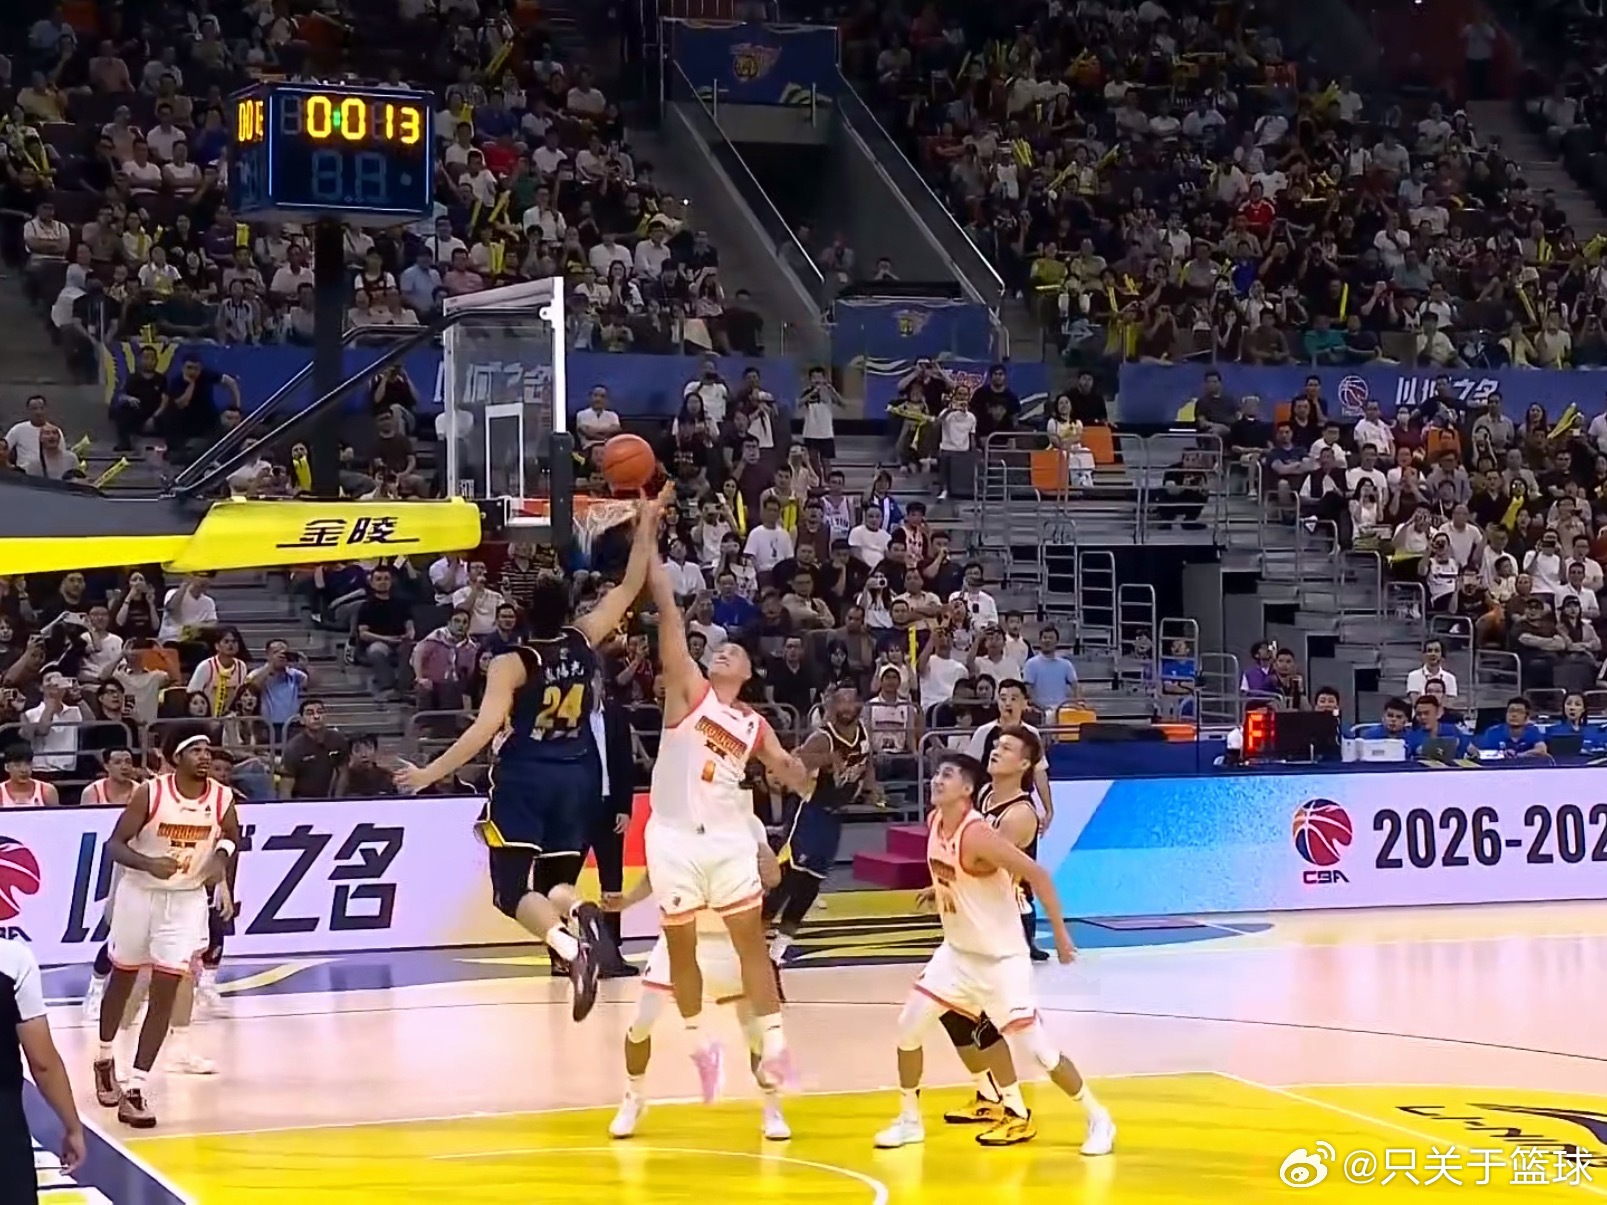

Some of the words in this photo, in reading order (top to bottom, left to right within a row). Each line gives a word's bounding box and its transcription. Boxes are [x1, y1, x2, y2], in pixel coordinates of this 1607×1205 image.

[276, 516, 420, 548] 金陵
[534, 683, 585, 729] 24
[1373, 802, 1607, 869] 2026-202
[1303, 870, 1350, 884] CBA
